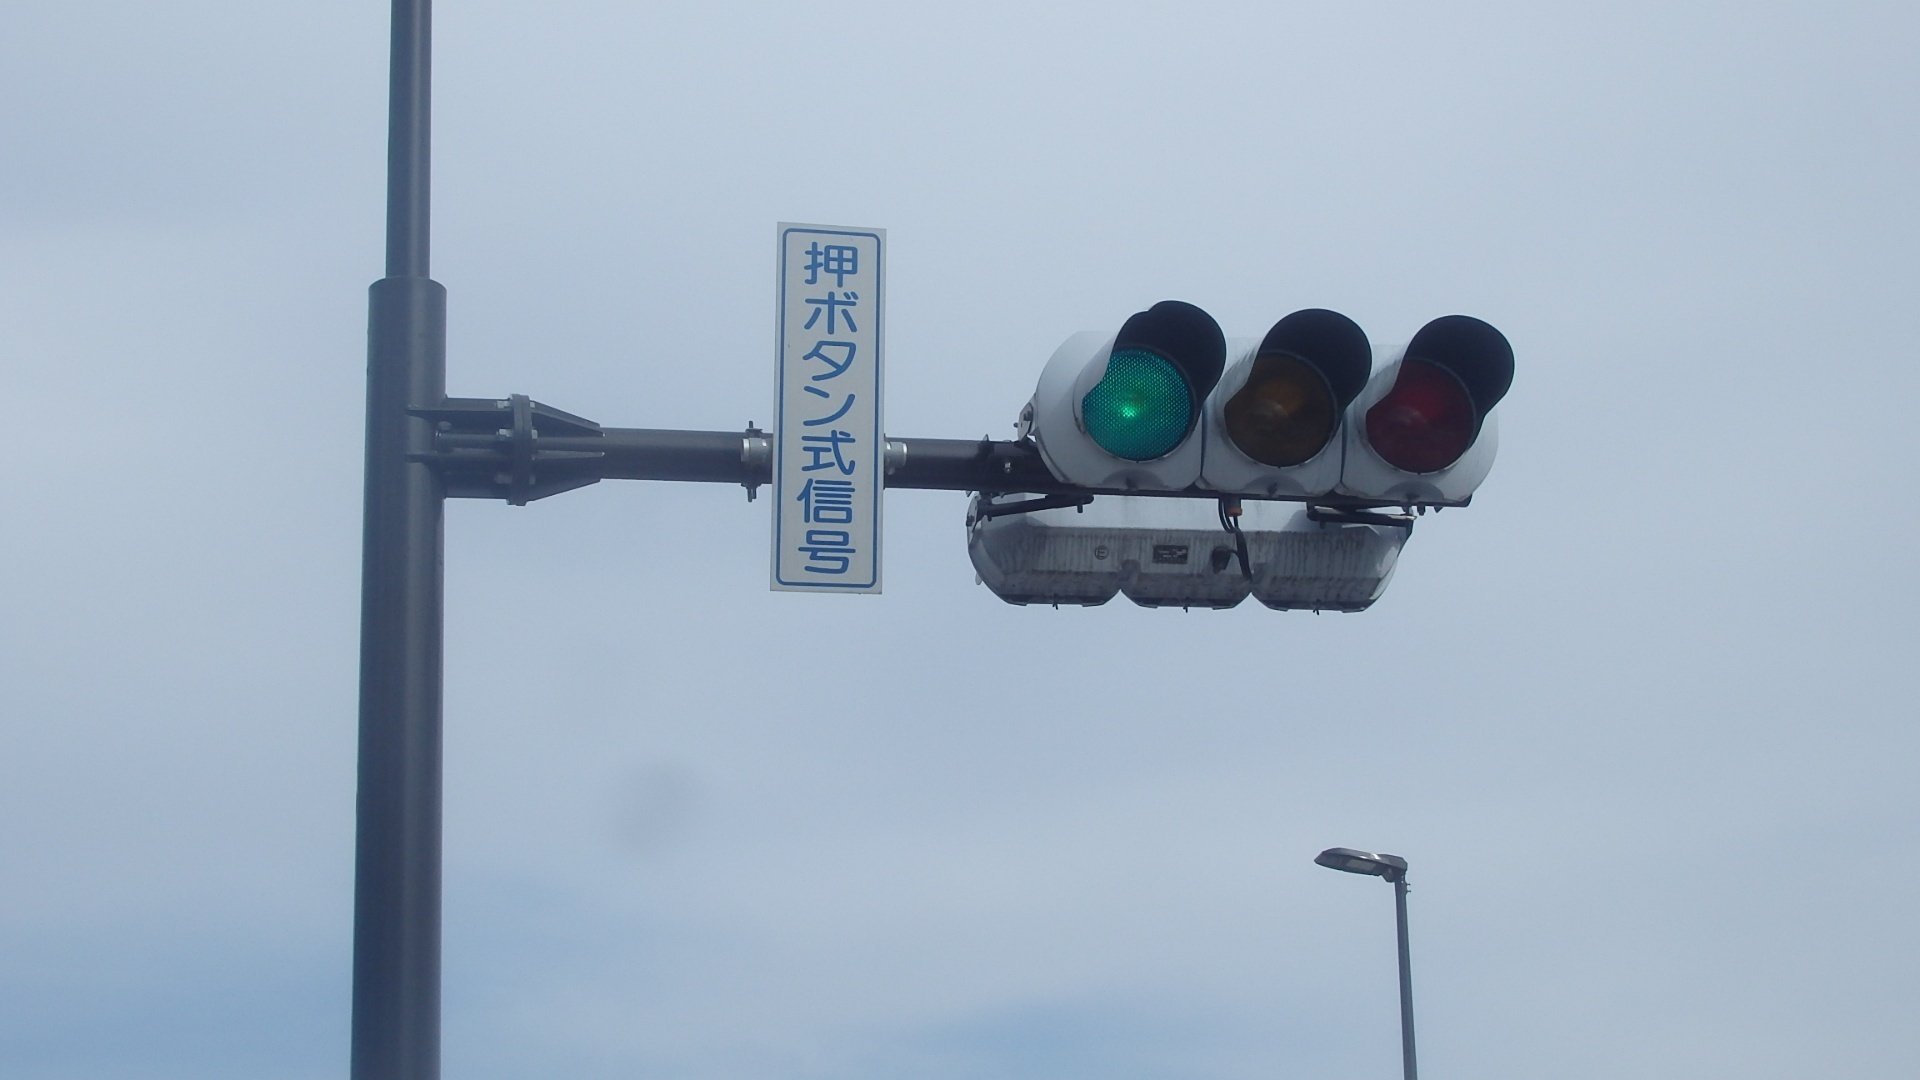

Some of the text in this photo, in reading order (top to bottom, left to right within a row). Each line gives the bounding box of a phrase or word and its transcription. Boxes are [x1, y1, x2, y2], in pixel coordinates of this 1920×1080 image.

[797, 241, 859, 574] 押ボタン式信号
